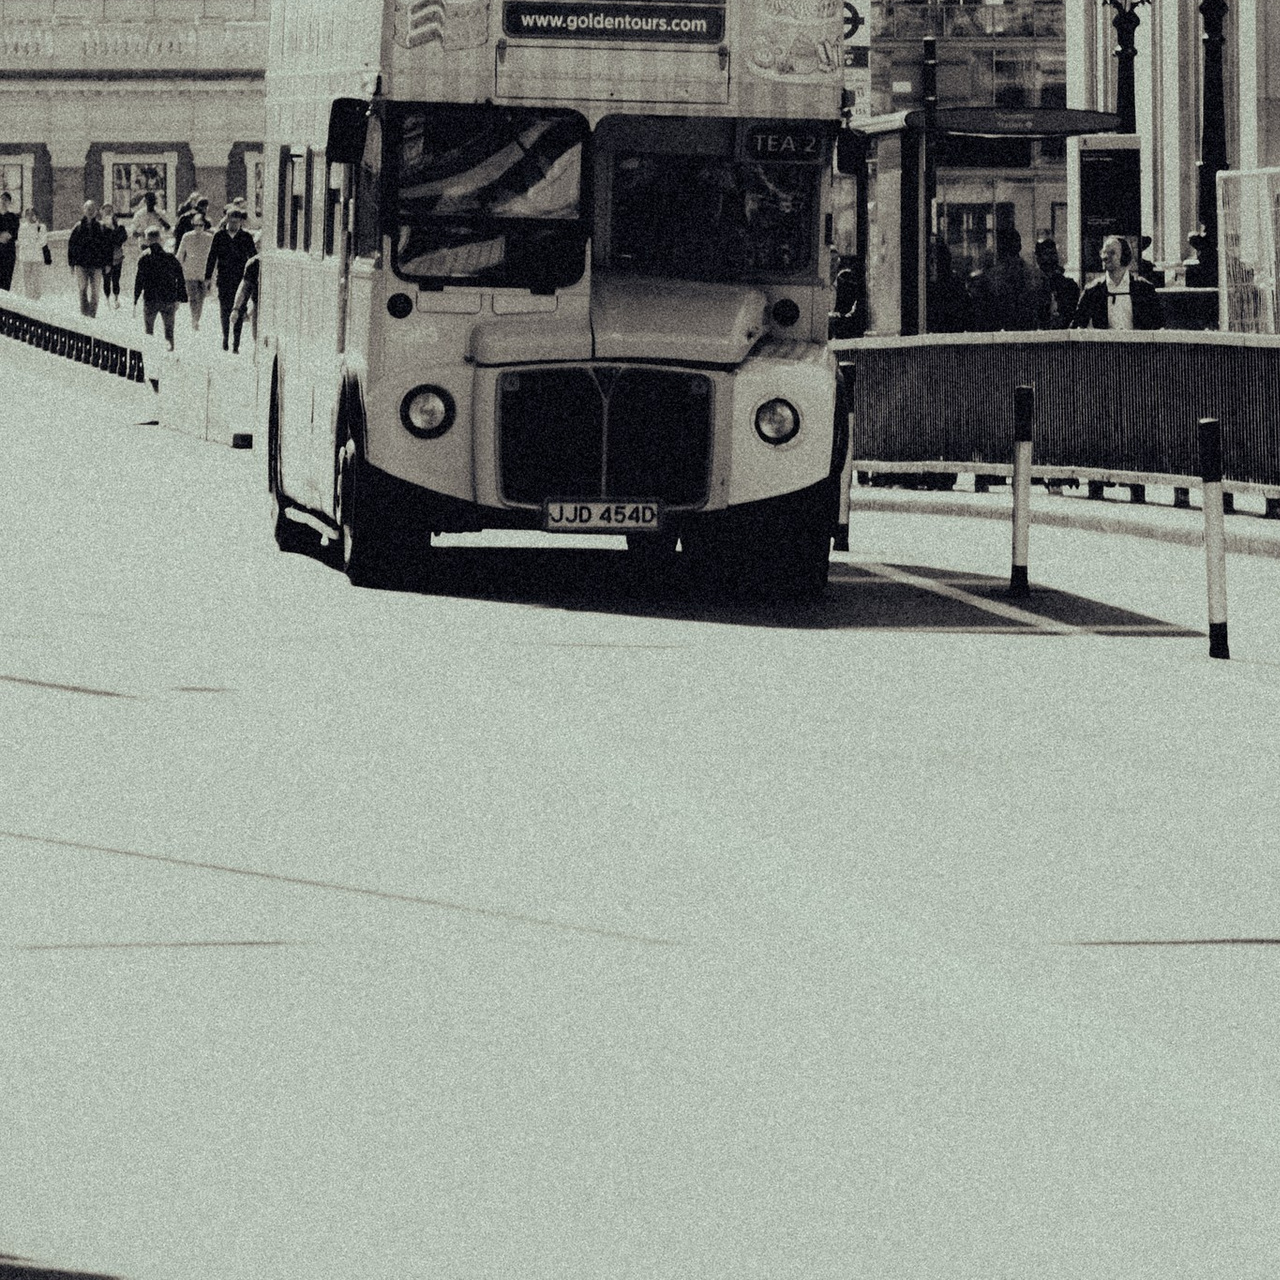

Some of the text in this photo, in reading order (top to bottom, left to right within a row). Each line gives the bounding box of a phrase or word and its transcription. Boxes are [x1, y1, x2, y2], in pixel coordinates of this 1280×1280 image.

[520, 13, 707, 32] www.goldentours.com
[755, 134, 818, 153] TEA 2
[550, 505, 656, 524] JJD 454D
